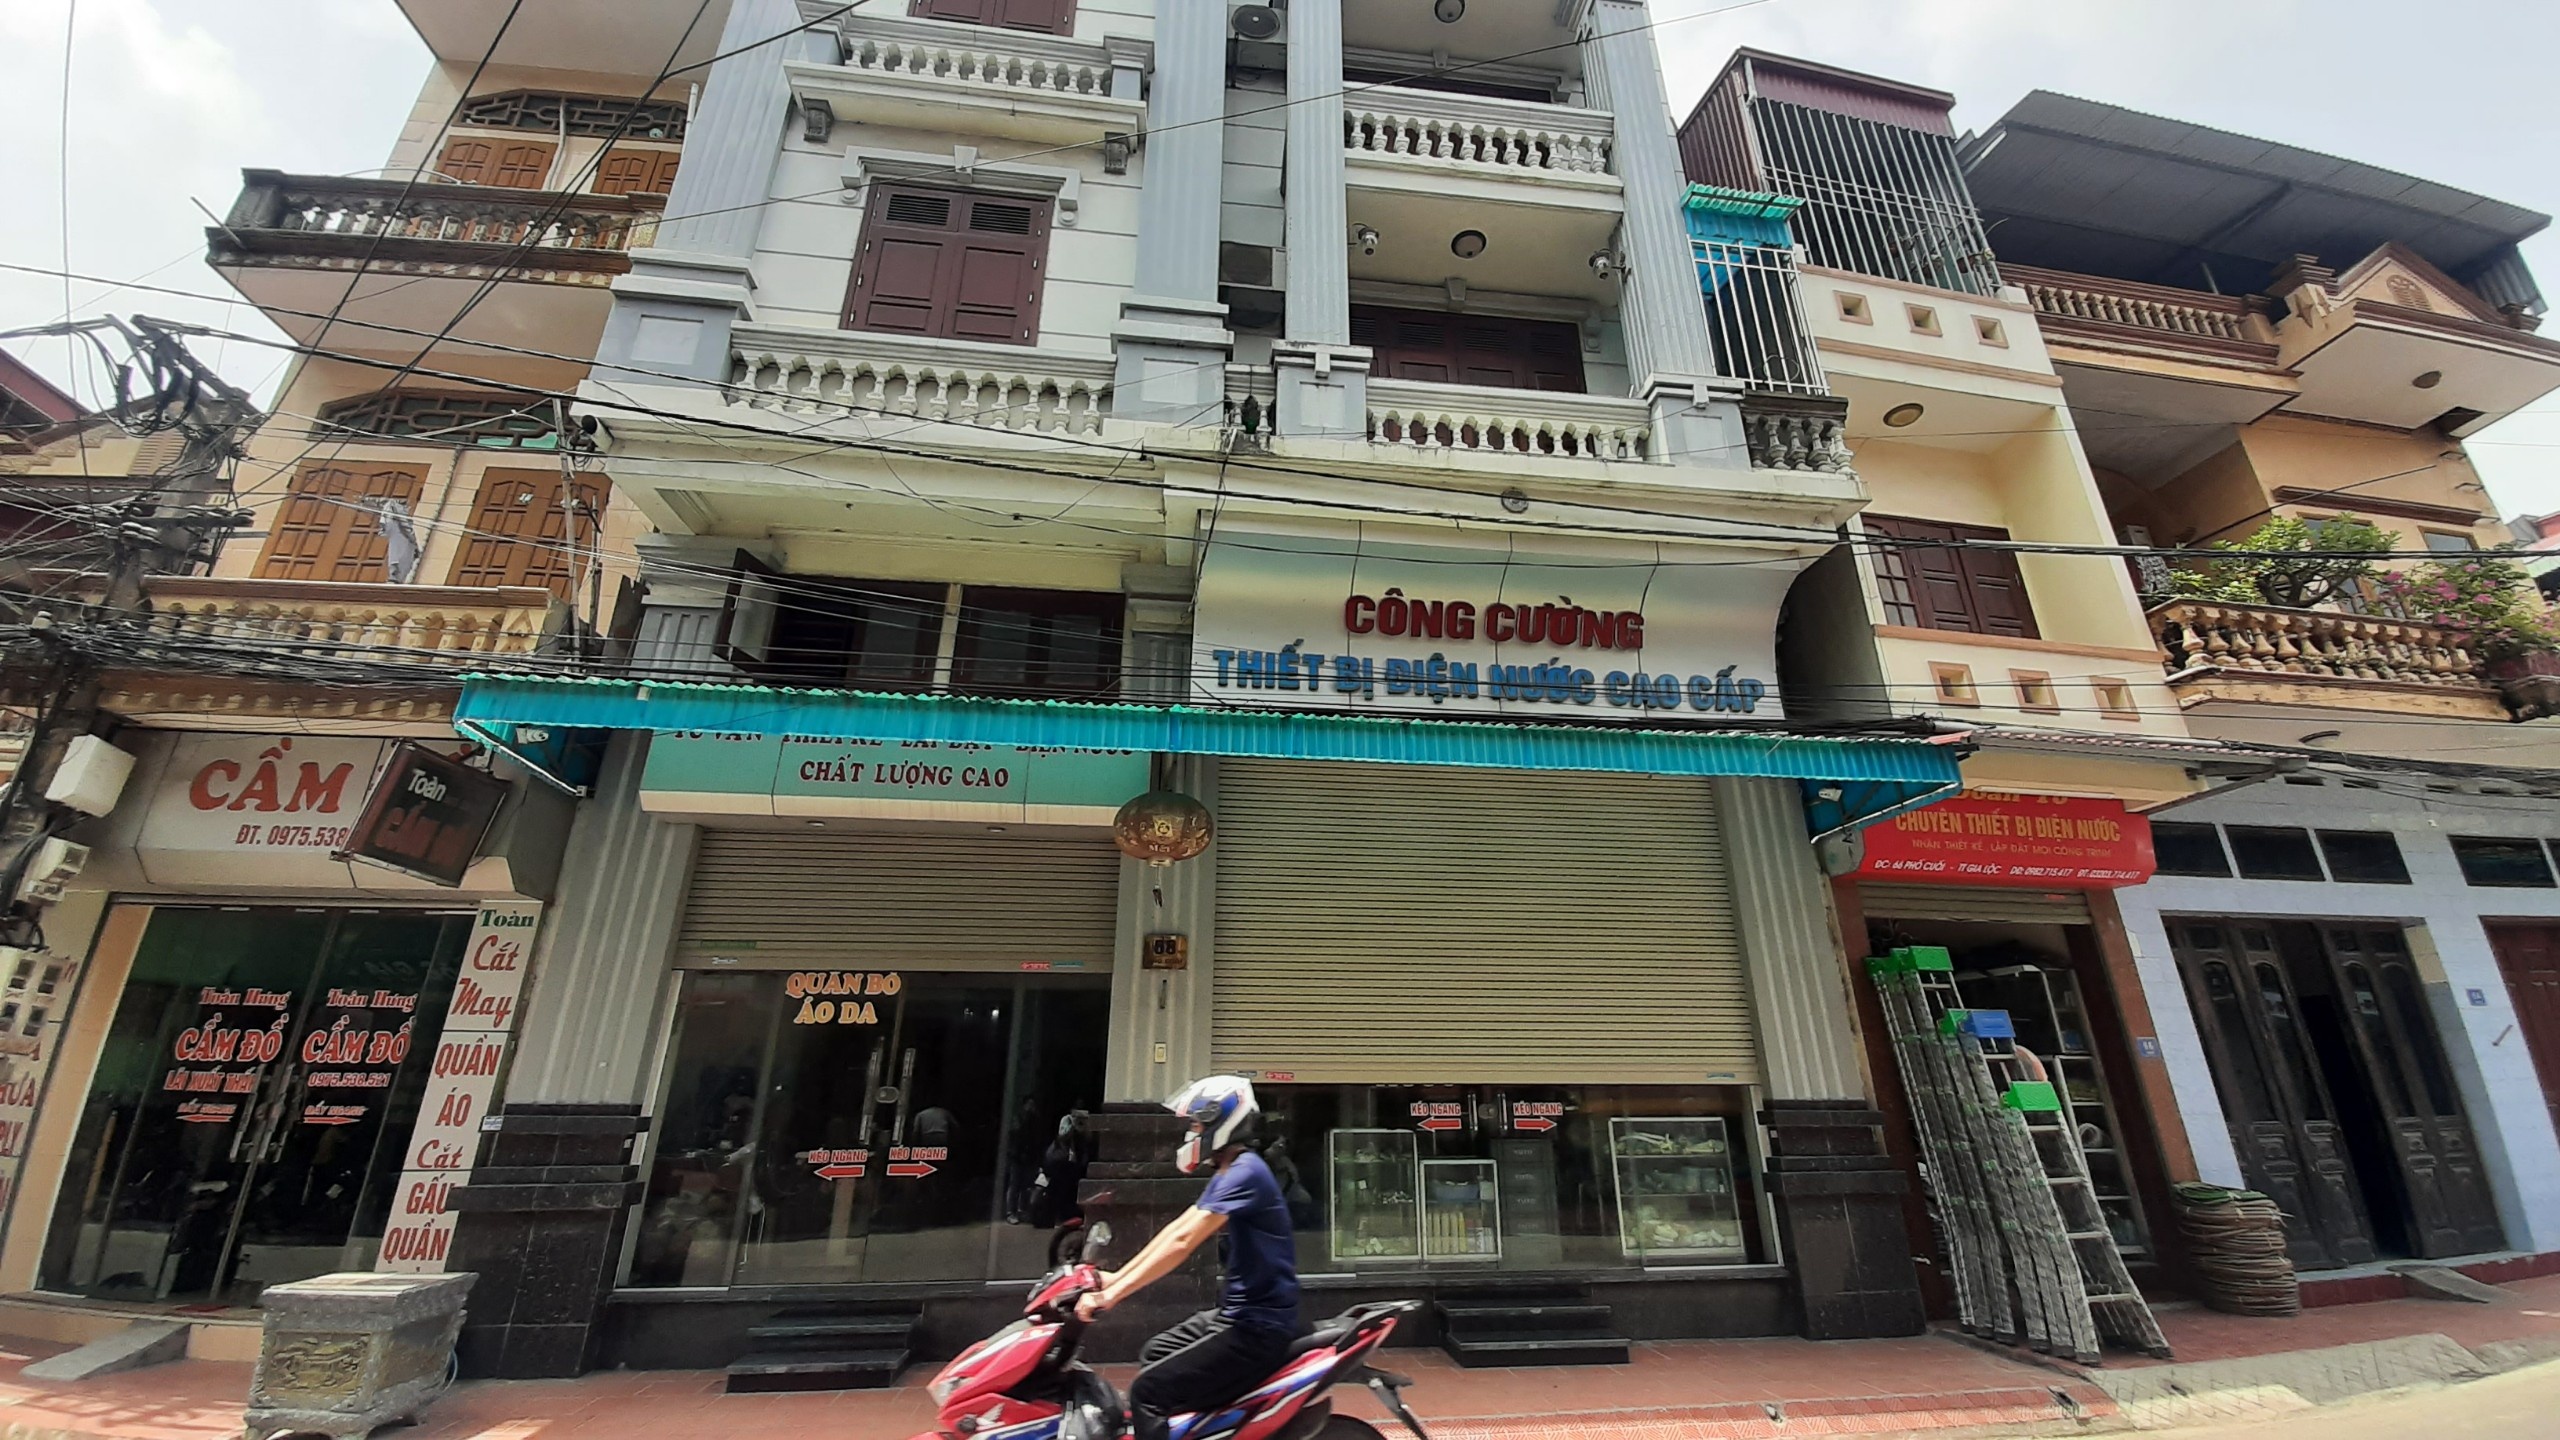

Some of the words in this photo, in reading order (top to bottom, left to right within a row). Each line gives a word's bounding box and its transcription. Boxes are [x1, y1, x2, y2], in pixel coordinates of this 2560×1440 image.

[1344, 588, 1476, 640] CÔNG
[1485, 595, 1645, 650] CƯỜNG
[1213, 638, 1325, 691] THIẾT
[1334, 656, 1374, 700] BỊ
[1489, 657, 1596, 705] NƯỚC
[1604, 670, 1682, 709] CAO
[1687, 665, 1765, 714] CẤP
[189, 737, 354, 813] CẦM
[408, 768, 447, 802] Toàn
[800, 753, 865, 784] CHẤT
[874, 760, 953, 789] LƯỢNG
[961, 767, 1009, 788] CAO
[1895, 808, 1963, 834] CHUYÊN
[1965, 808, 2010, 836] THIẾT
[2015, 815, 2034, 841] BỊ
[2035, 813, 2074, 842] ĐIỆN
[2076, 815, 2121, 842] NƯỚC
[480, 909, 535, 927] Toàn
[473, 934, 520, 972] Cắt
[451, 978, 512, 1028] May
[794, 996, 835, 1025] ÁO
[838, 1001, 878, 1025] DA
[175, 1012, 240, 1062] CẦM
[237, 1012, 290, 1063] ĐỒ
[303, 1014, 370, 1064] CẦM
[365, 1014, 417, 1064] ĐỒ
[435, 1034, 502, 1079] QUẦN
[435, 1087, 472, 1127] ÁO
[1410, 1101, 1428, 1117] KÉO
[1429, 1103, 1462, 1117] NGANG
[1513, 1101, 1531, 1116] KÉO
[1532, 1103, 1563, 1116] NGANG
[417, 1139, 463, 1169] Cắt
[830, 1149, 868, 1163] NGANG
[910, 1146, 948, 1161] NGANG
[383, 1218, 451, 1264] QUẦN
